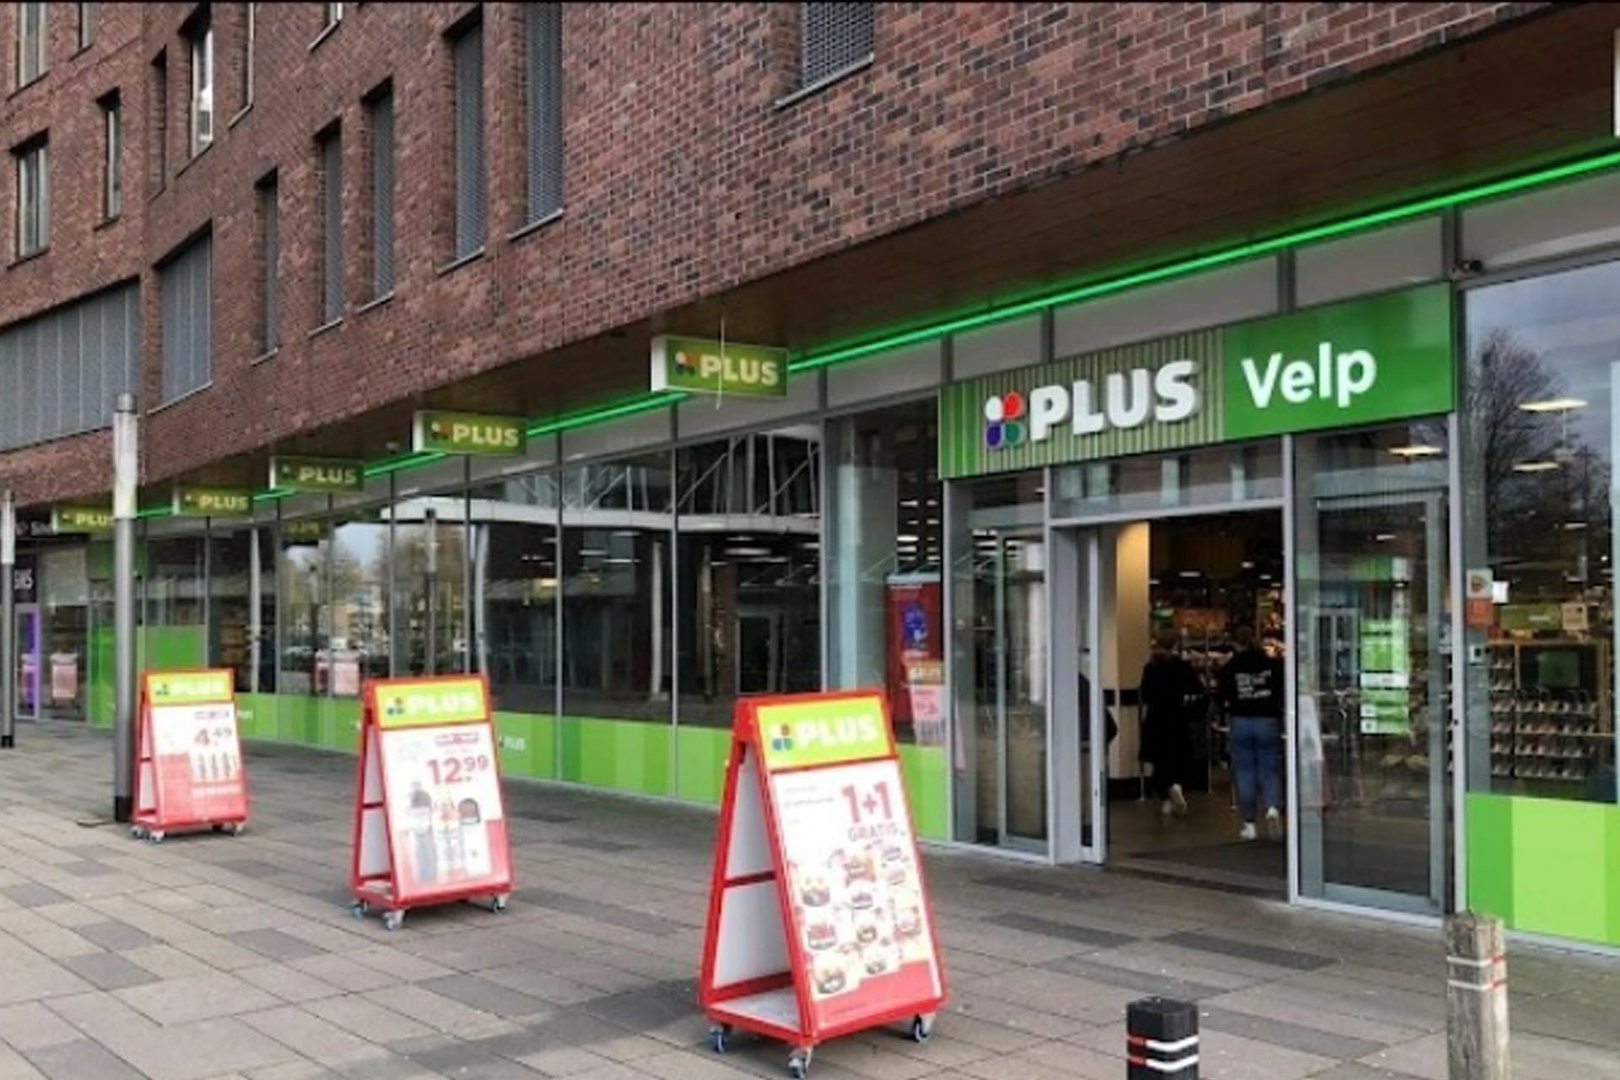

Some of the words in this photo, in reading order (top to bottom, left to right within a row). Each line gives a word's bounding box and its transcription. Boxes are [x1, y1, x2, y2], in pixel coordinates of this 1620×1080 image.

[700, 355, 779, 386] PLUS
[1029, 358, 1198, 441] PLUS
[1241, 342, 1377, 408] Velp
[452, 424, 519, 446] PLUS
[299, 466, 357, 484] PLUS
[200, 494, 249, 510] PLUS
[405, 692, 478, 715] PLUS
[796, 714, 878, 748] PLUS
[840, 780, 894, 824] 1+1
